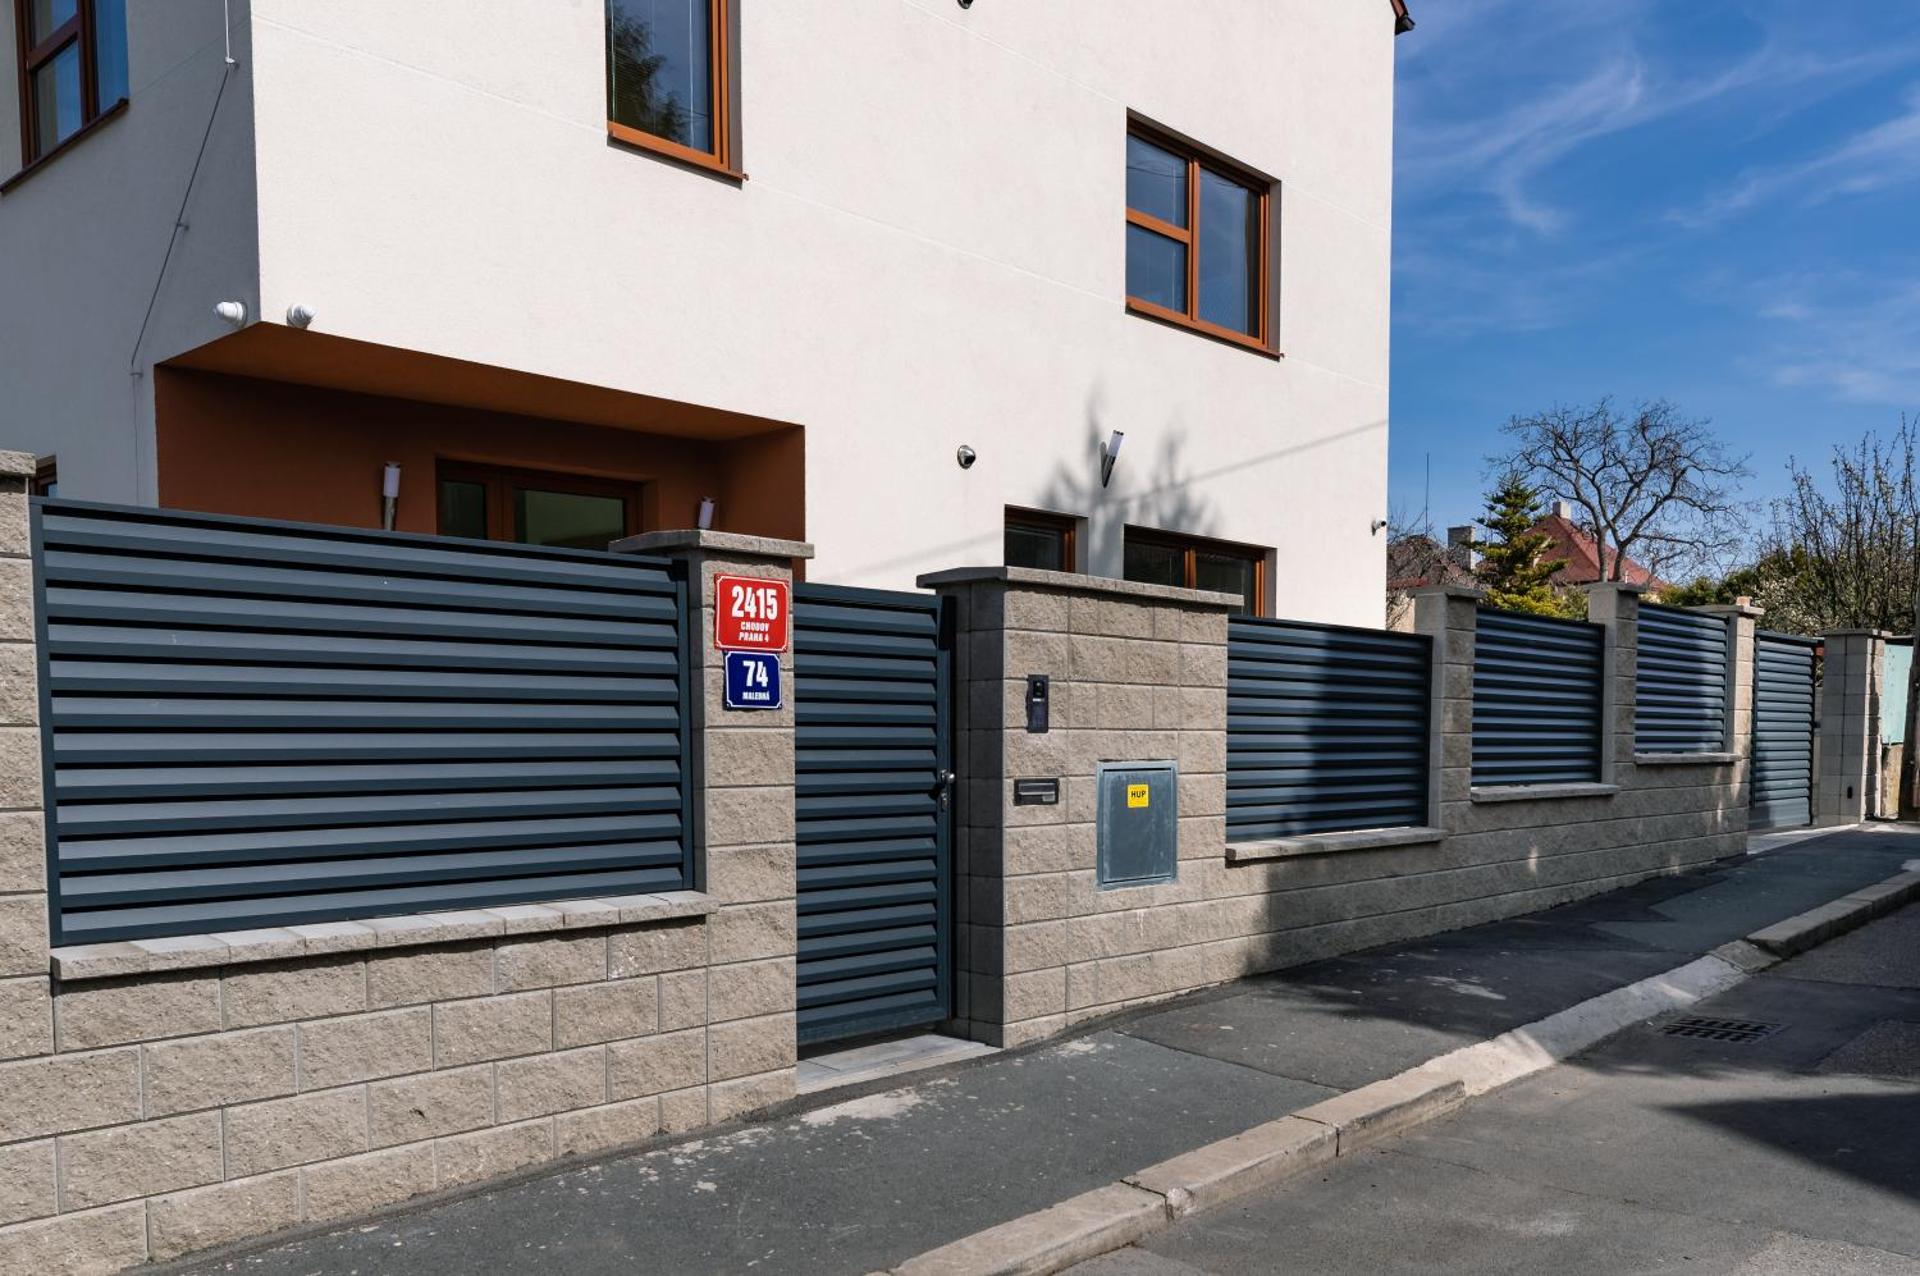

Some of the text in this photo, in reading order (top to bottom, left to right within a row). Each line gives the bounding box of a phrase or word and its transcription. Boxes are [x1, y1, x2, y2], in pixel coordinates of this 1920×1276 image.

[731, 585, 778, 621] 2415
[740, 621, 769, 632] CHODOV
[738, 632, 769, 643] PRAHA 4
[742, 660, 769, 687] 74
[1131, 790, 1146, 798] HUP
